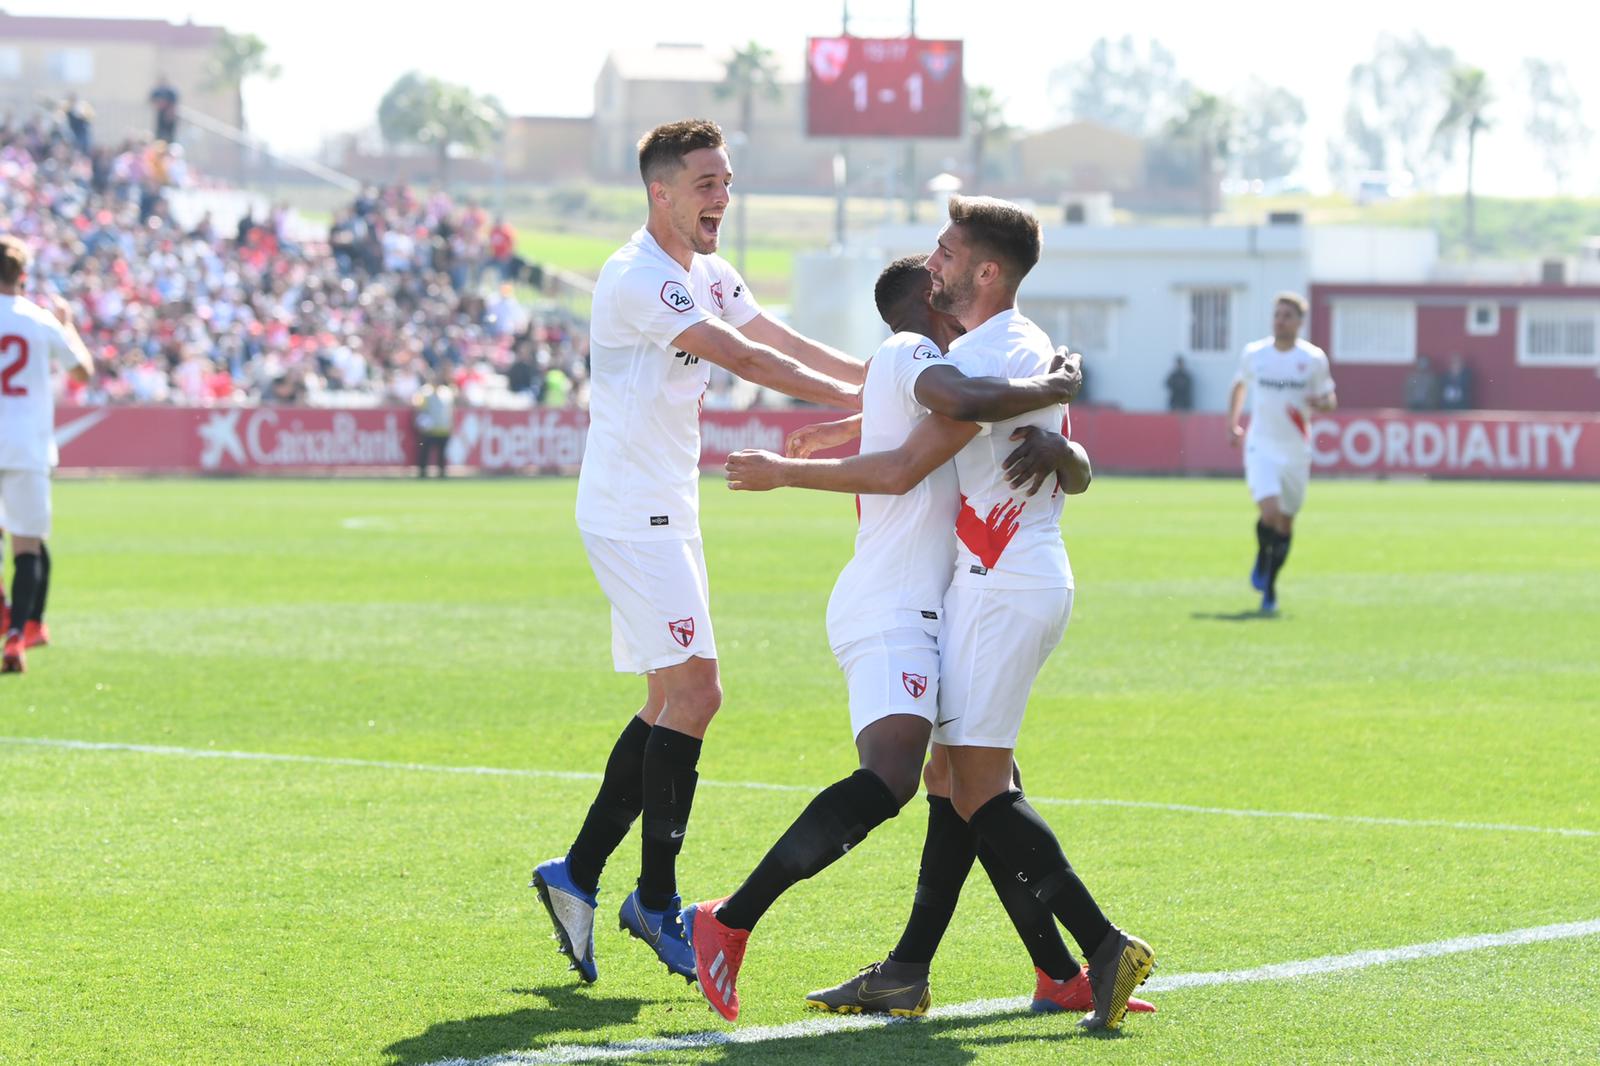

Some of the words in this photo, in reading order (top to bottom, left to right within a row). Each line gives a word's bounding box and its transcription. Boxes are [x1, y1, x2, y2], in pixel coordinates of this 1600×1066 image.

[849, 71, 868, 113] 1
[904, 72, 923, 113] 1
[0, 335, 29, 396] 2
[246, 408, 405, 465] CaixaBank
[480, 413, 589, 468] betfai
[1310, 420, 1582, 469] CORDIALITY
